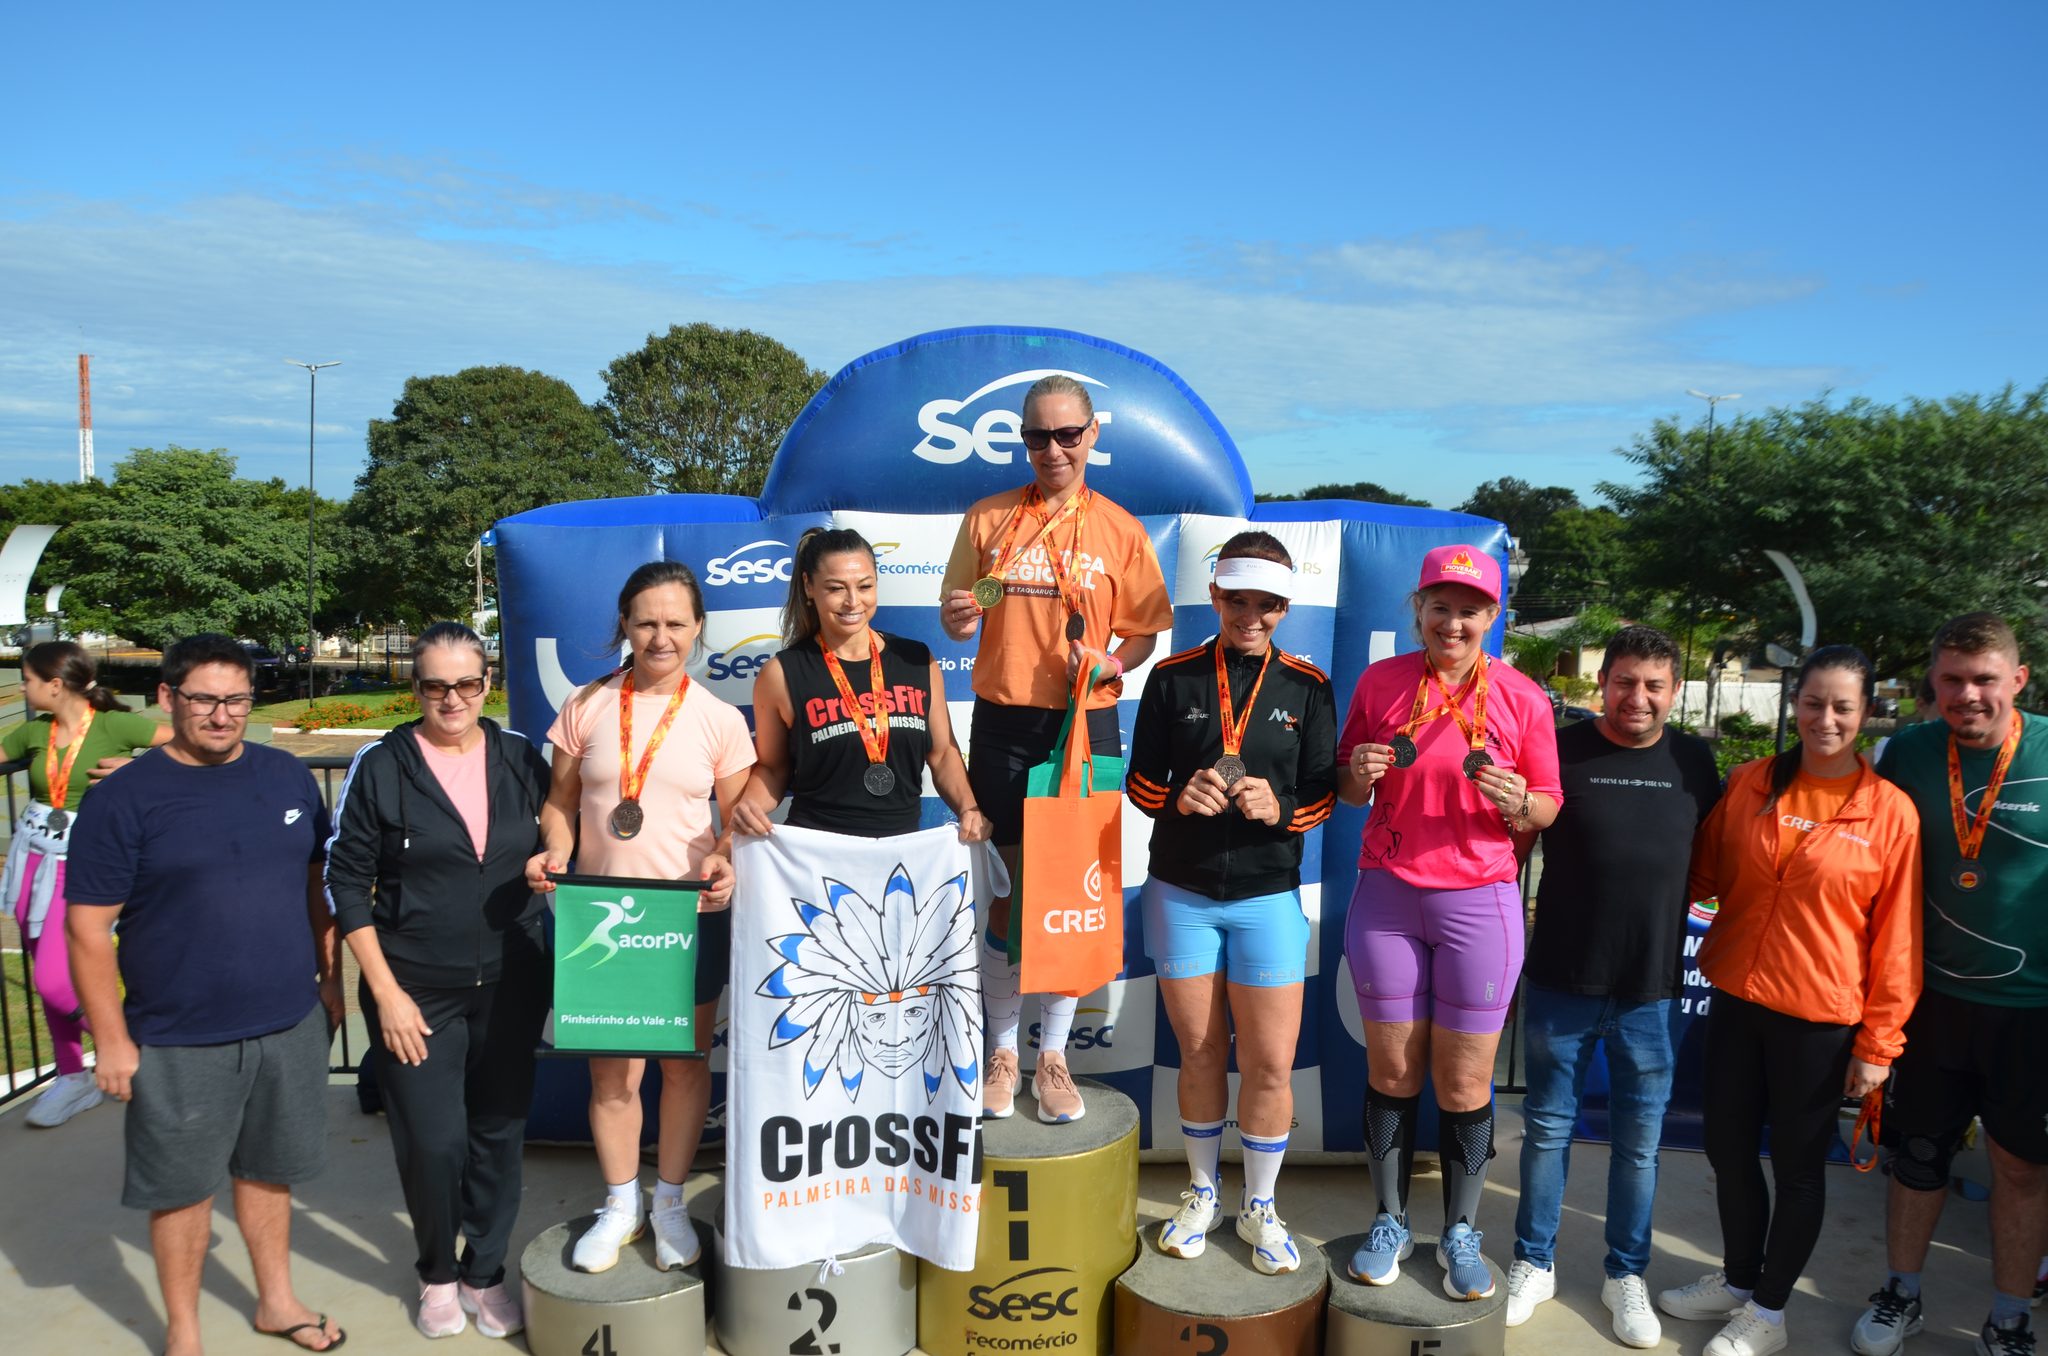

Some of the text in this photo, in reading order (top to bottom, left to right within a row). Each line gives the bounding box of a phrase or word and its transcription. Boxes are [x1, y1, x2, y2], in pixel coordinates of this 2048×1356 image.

[1303, 562, 1322, 575] RS
[1645, 780, 1672, 789] BRAND
[619, 932, 693, 950] acorPV
[561, 1014, 624, 1025] Pinheirinho
[626, 1015, 641, 1026] do
[642, 1016, 666, 1026] Vale
[674, 1016, 689, 1026] RS
[764, 1176, 872, 1210] PALMEIRA
[885, 1175, 923, 1196] DAS
[994, 1171, 1028, 1260] 1
[787, 1288, 840, 1356] 2
[966, 1331, 1078, 1350] Fecomércio
